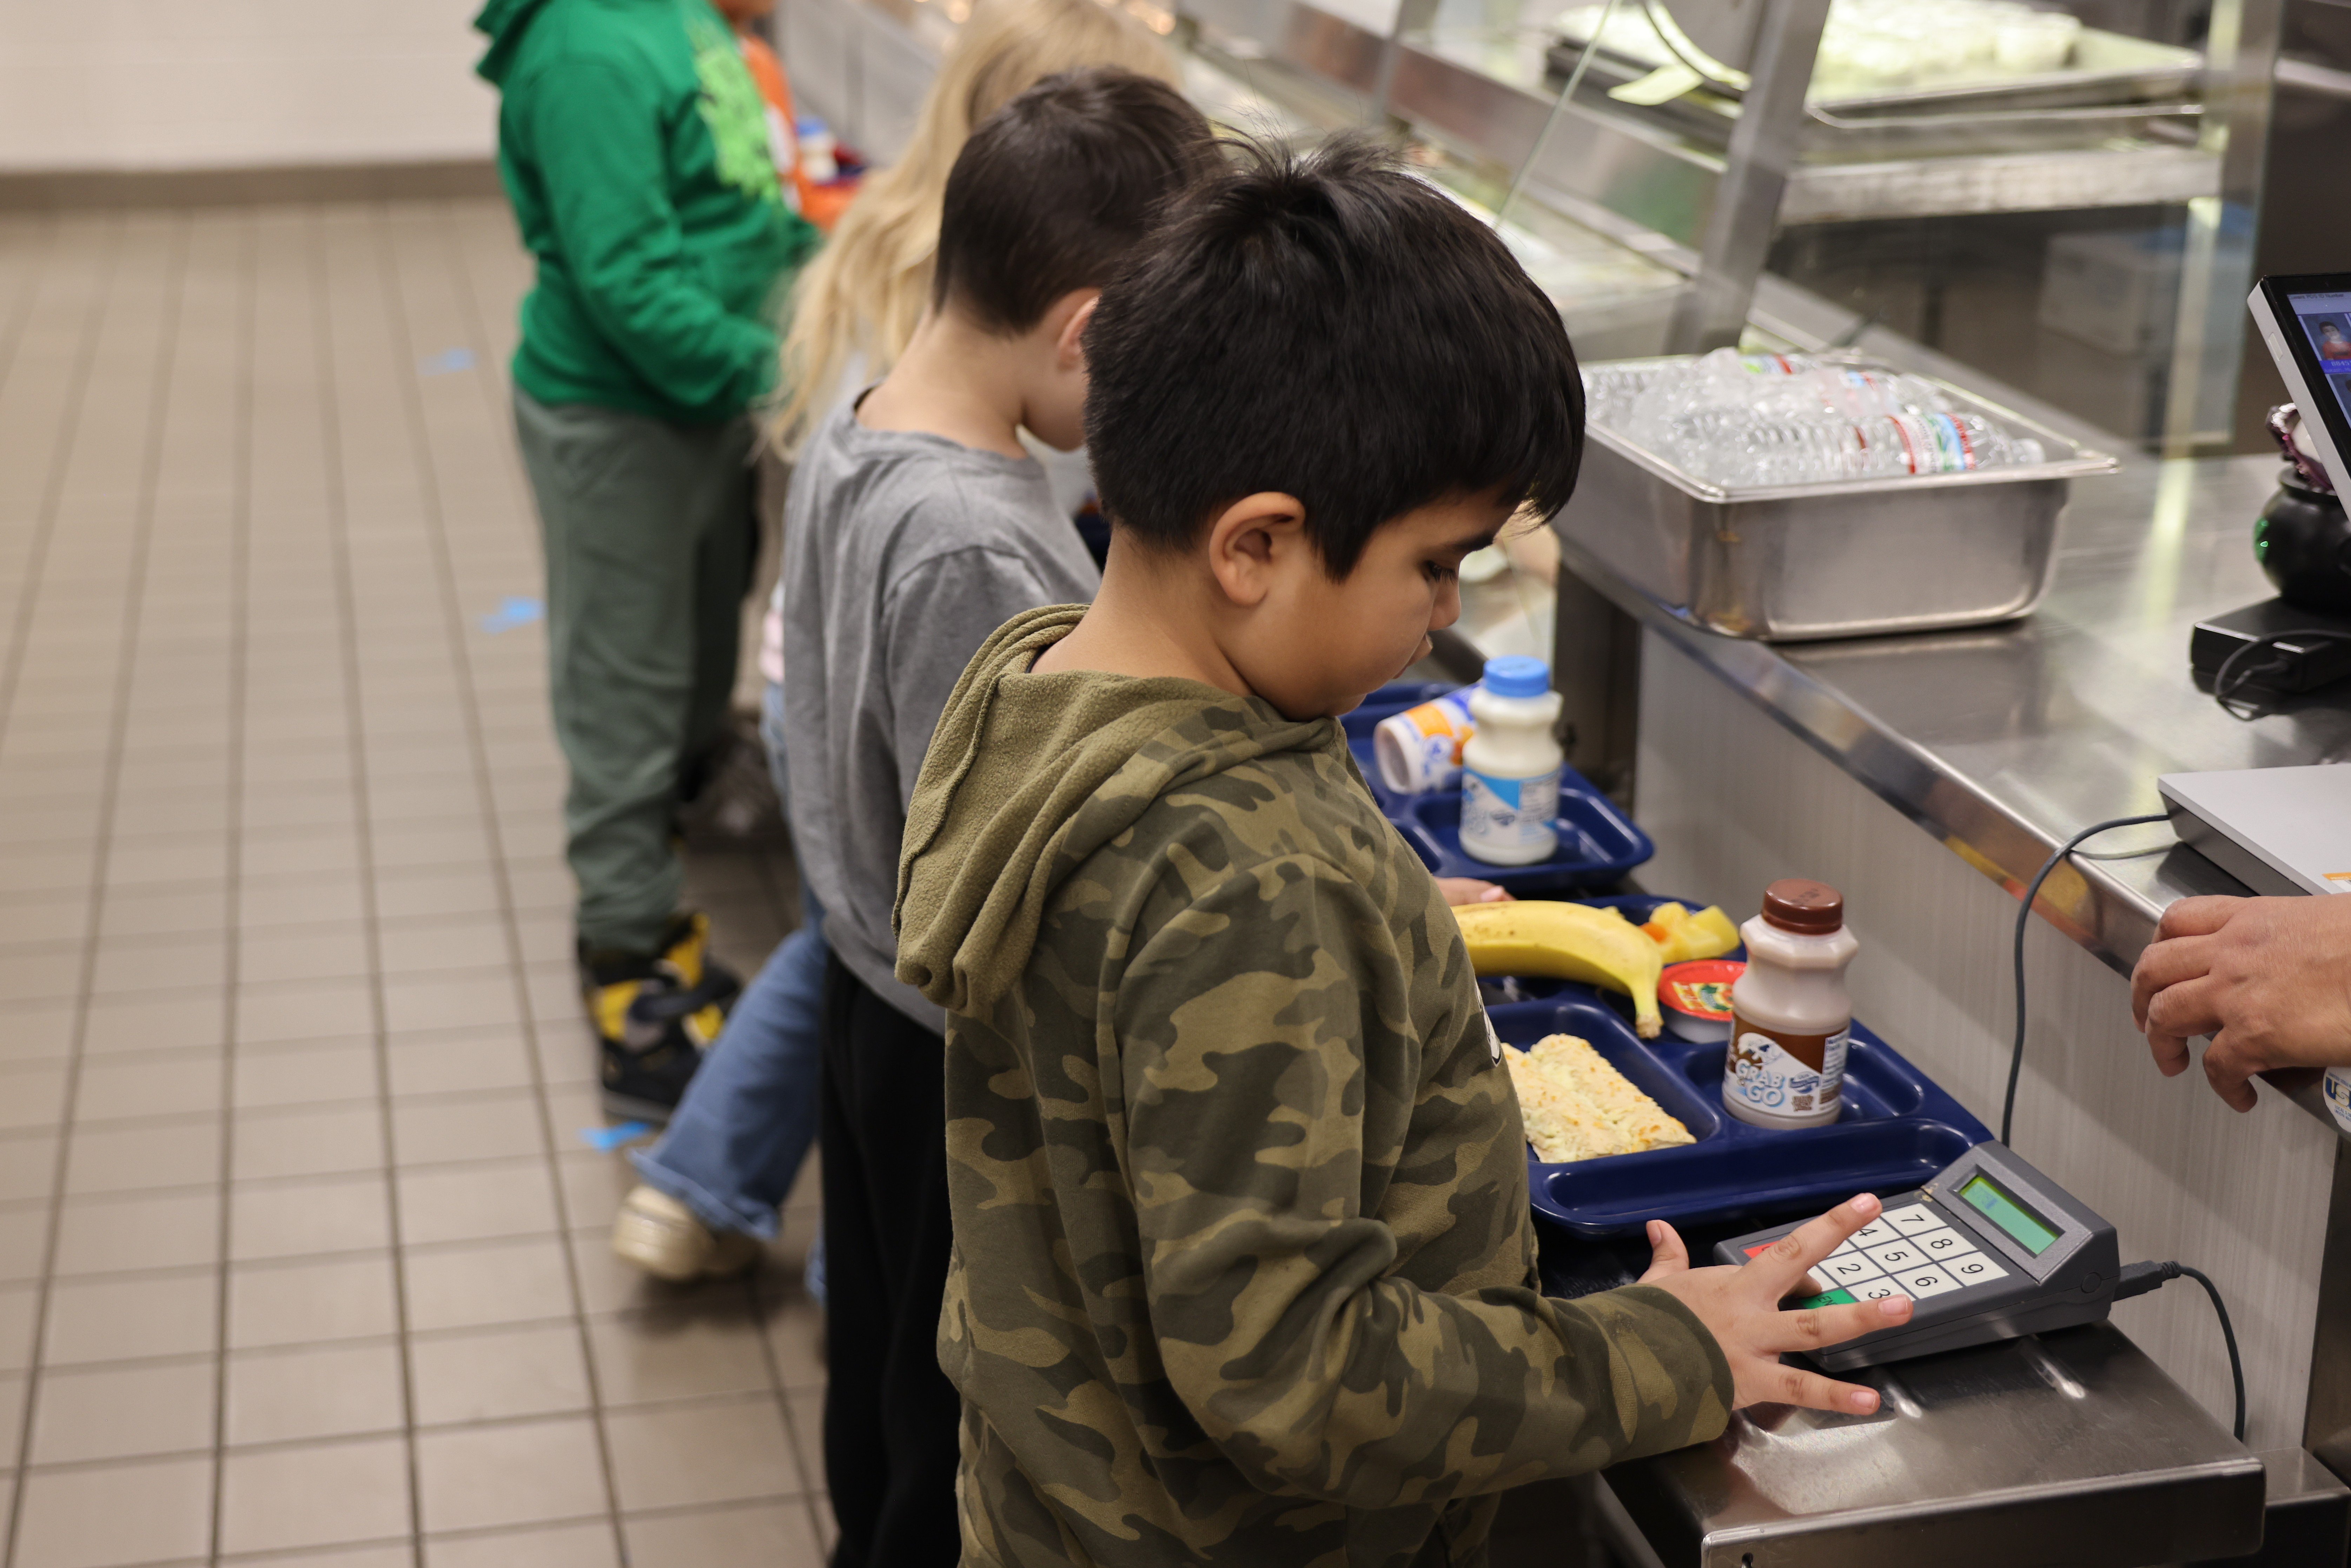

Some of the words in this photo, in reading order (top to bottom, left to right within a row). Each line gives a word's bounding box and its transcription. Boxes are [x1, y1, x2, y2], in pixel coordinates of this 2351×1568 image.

[1735, 1058, 1784, 1089] GRAB
[1746, 1081, 1784, 1107] GO
[2326, 1076, 2351, 1110] US
[1931, 1238, 1953, 1249] 8
[1884, 1251, 1909, 1261] 5
[1836, 1263, 1861, 1275] 2
[1961, 1264, 1984, 1274] 9
[1915, 1276, 1938, 1286] 6
[1868, 1289, 1890, 1299] 3
